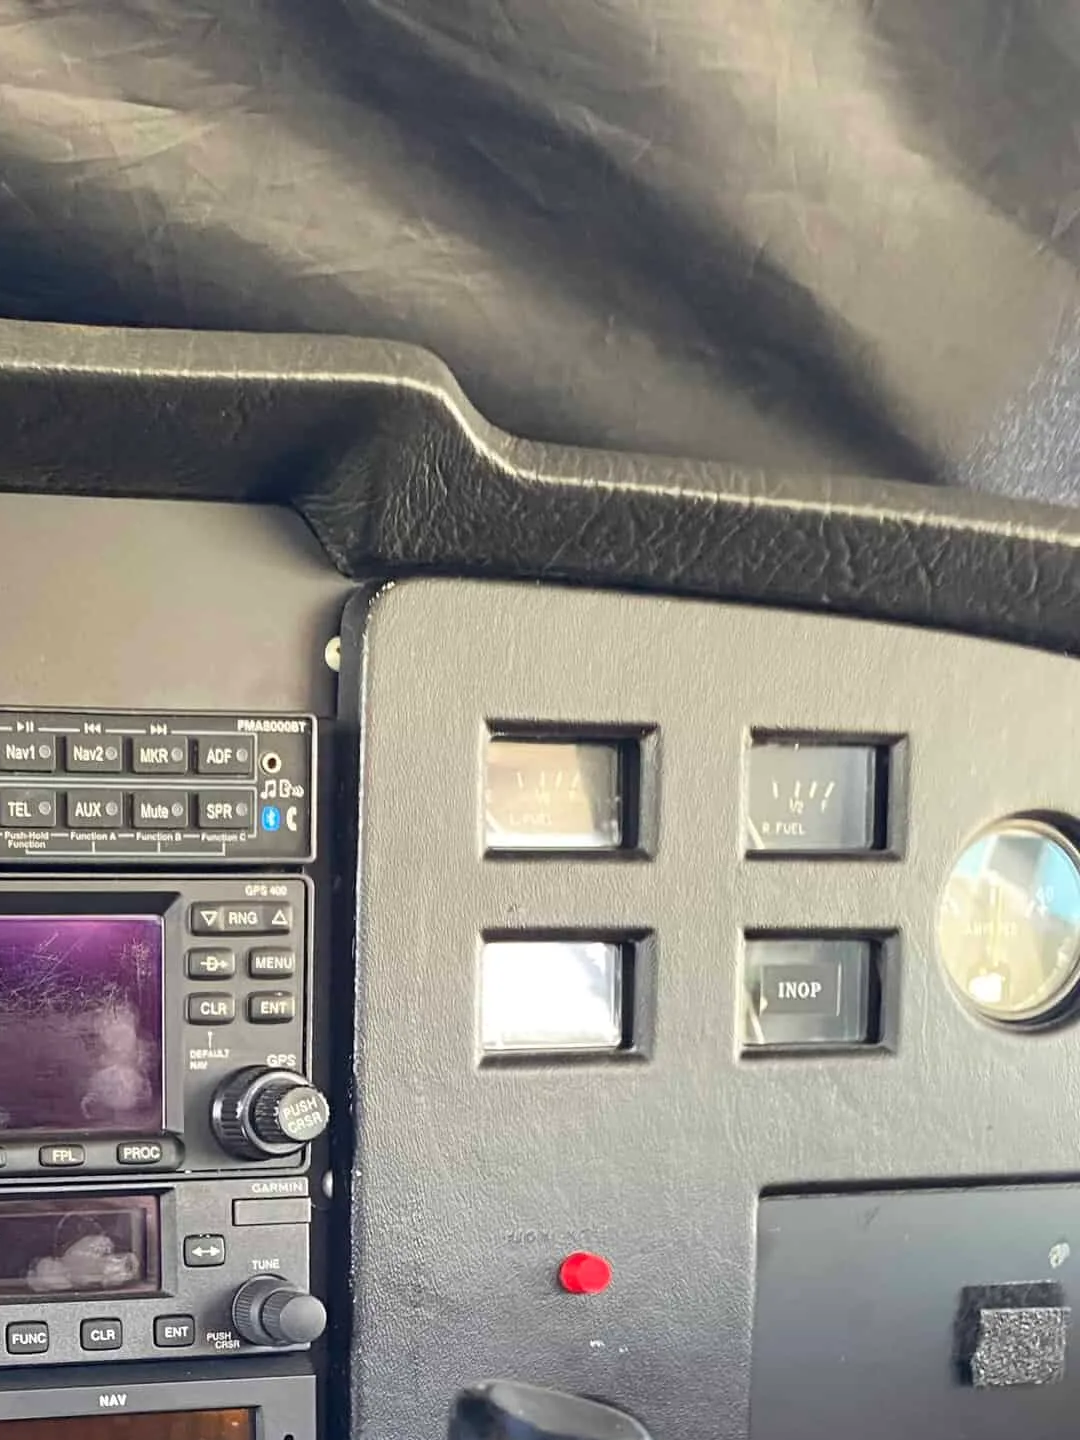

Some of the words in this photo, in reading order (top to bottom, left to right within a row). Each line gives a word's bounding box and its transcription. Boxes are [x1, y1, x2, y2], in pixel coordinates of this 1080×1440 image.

[5, 745, 35, 760] Nav1
[73, 747, 103, 762] Nav2
[140, 749, 168, 763] MKR
[206, 750, 232, 764] ADF
[8, 802, 32, 817] TEL
[75, 803, 102, 817] AUX
[140, 805, 169, 819] Mute
[206, 804, 232, 819] SPR
[776, 822, 806, 835] FUEL
[228, 911, 258, 925] RNG
[255, 956, 292, 969] MENU
[777, 980, 822, 999] INOP
[200, 1002, 227, 1016] CLR
[260, 1001, 287, 1015] ENT
[267, 1053, 297, 1067] GPS
[282, 1096, 318, 1121] PUSH
[288, 1110, 322, 1134] CRSR
[52, 1148, 76, 1163] FPL
[123, 1145, 160, 1161] PROC
[252, 1182, 303, 1194] GARMIN
[252, 1259, 280, 1270] TUNE
[12, 1332, 47, 1345] FUNC
[91, 1329, 116, 1342] CLR
[164, 1326, 189, 1339] ENT
[99, 1394, 127, 1407] NAV
